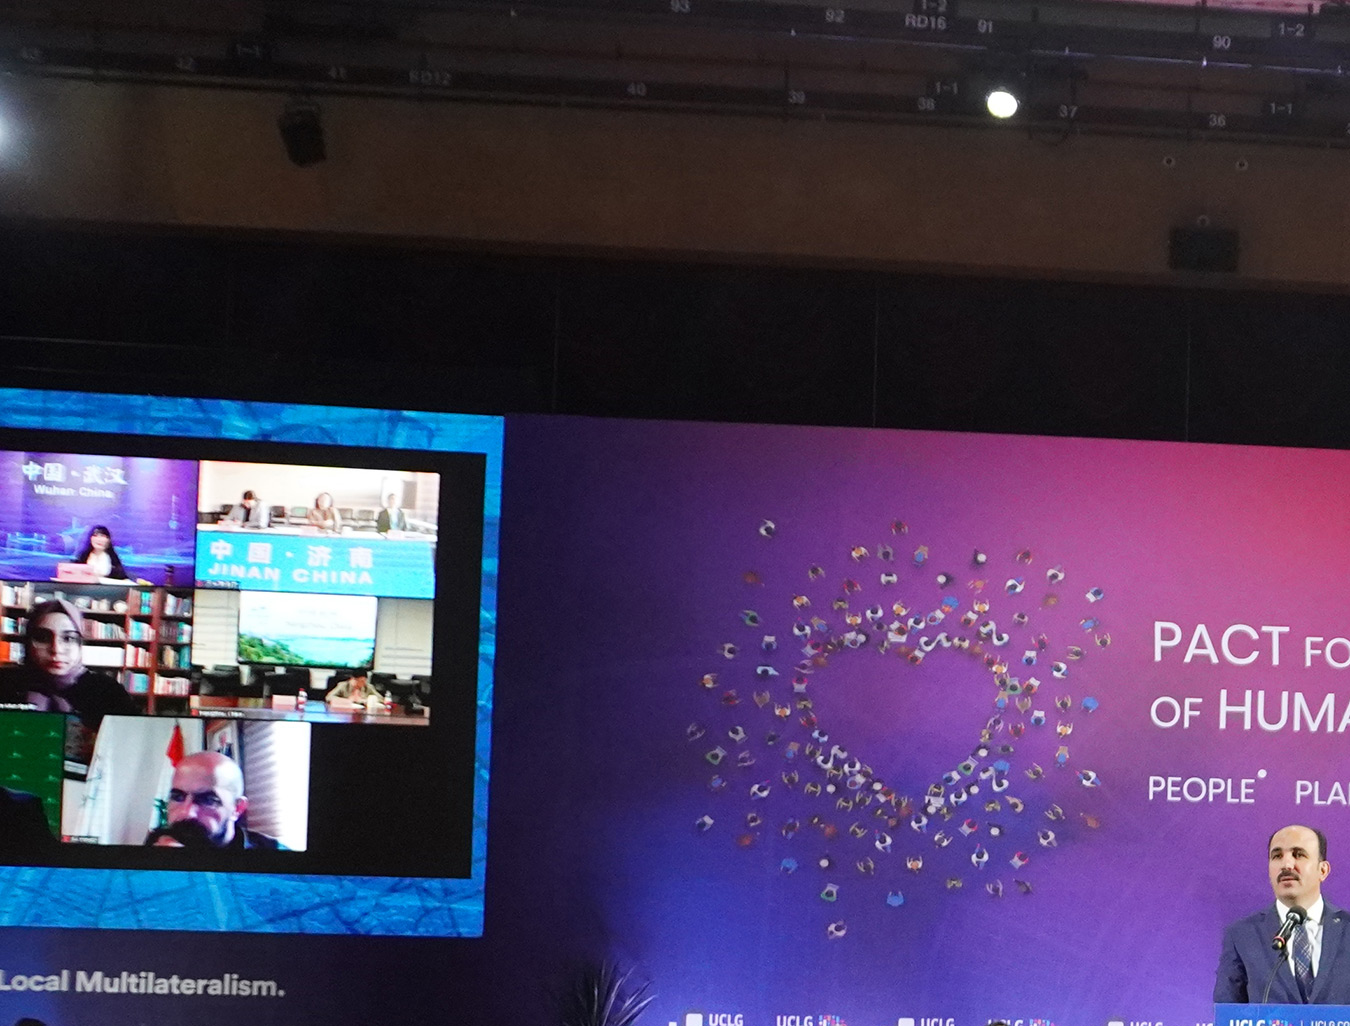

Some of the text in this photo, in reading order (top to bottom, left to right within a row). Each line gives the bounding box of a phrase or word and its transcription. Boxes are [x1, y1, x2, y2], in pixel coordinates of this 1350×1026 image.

[905, 14, 948, 31] RD16
[977, 19, 994, 34] 91
[1278, 21, 1305, 38] 1-2
[1212, 35, 1232, 51] 90
[627, 82, 647, 97] 40
[935, 81, 958, 95] 1-1
[1058, 104, 1077, 119] 37
[1270, 101, 1293, 115] 1-1
[208, 563, 374, 585] JINAN CHINA
[1152, 621, 1290, 667] PACT
[1149, 696, 1204, 729] OF
[1148, 775, 1256, 804] PEOPLE
[0, 968, 286, 997] Local Multilateralism.
